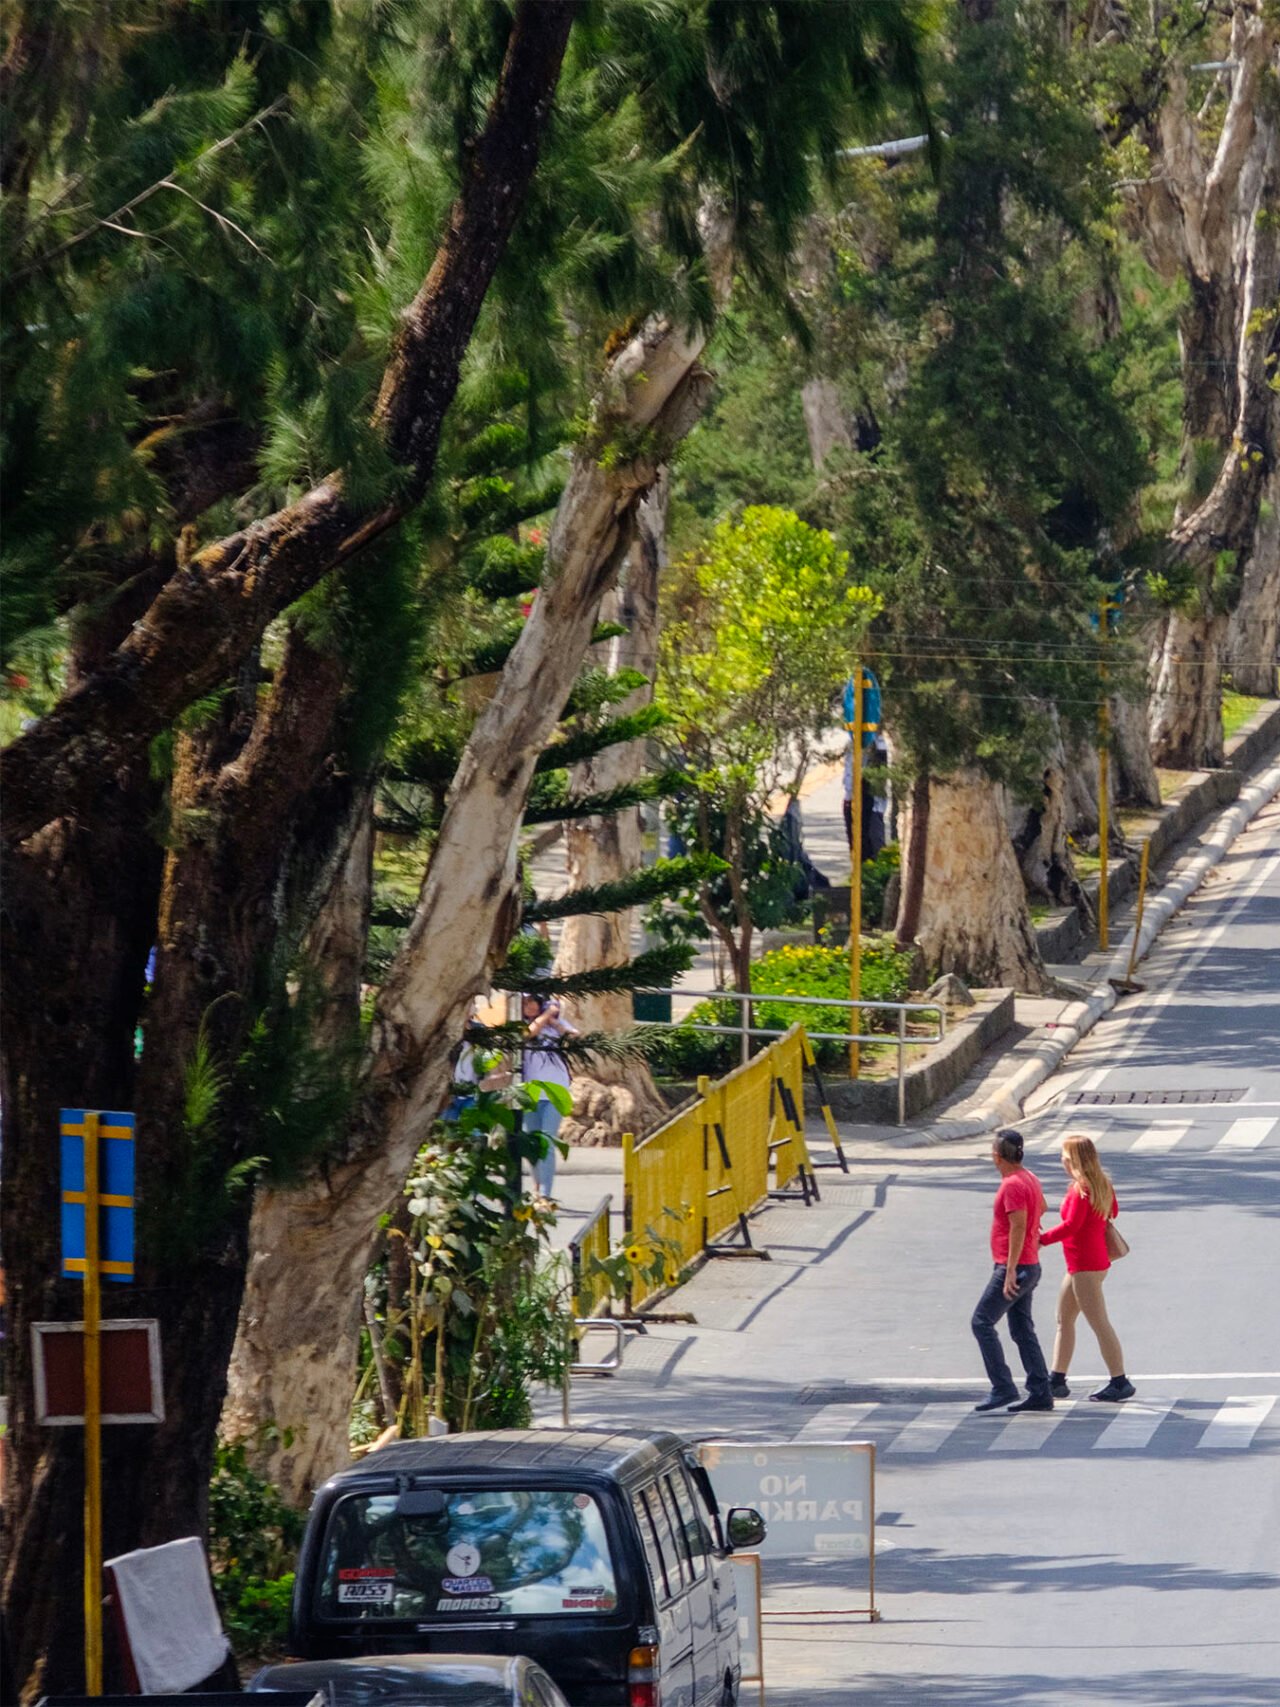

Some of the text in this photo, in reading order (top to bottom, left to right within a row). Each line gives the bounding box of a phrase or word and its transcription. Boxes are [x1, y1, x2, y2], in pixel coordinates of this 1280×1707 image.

[444, 1578, 491, 1589] QUARTER
[344, 1584, 387, 1597] ROSS
[436, 1598, 500, 1612] MOROSO
